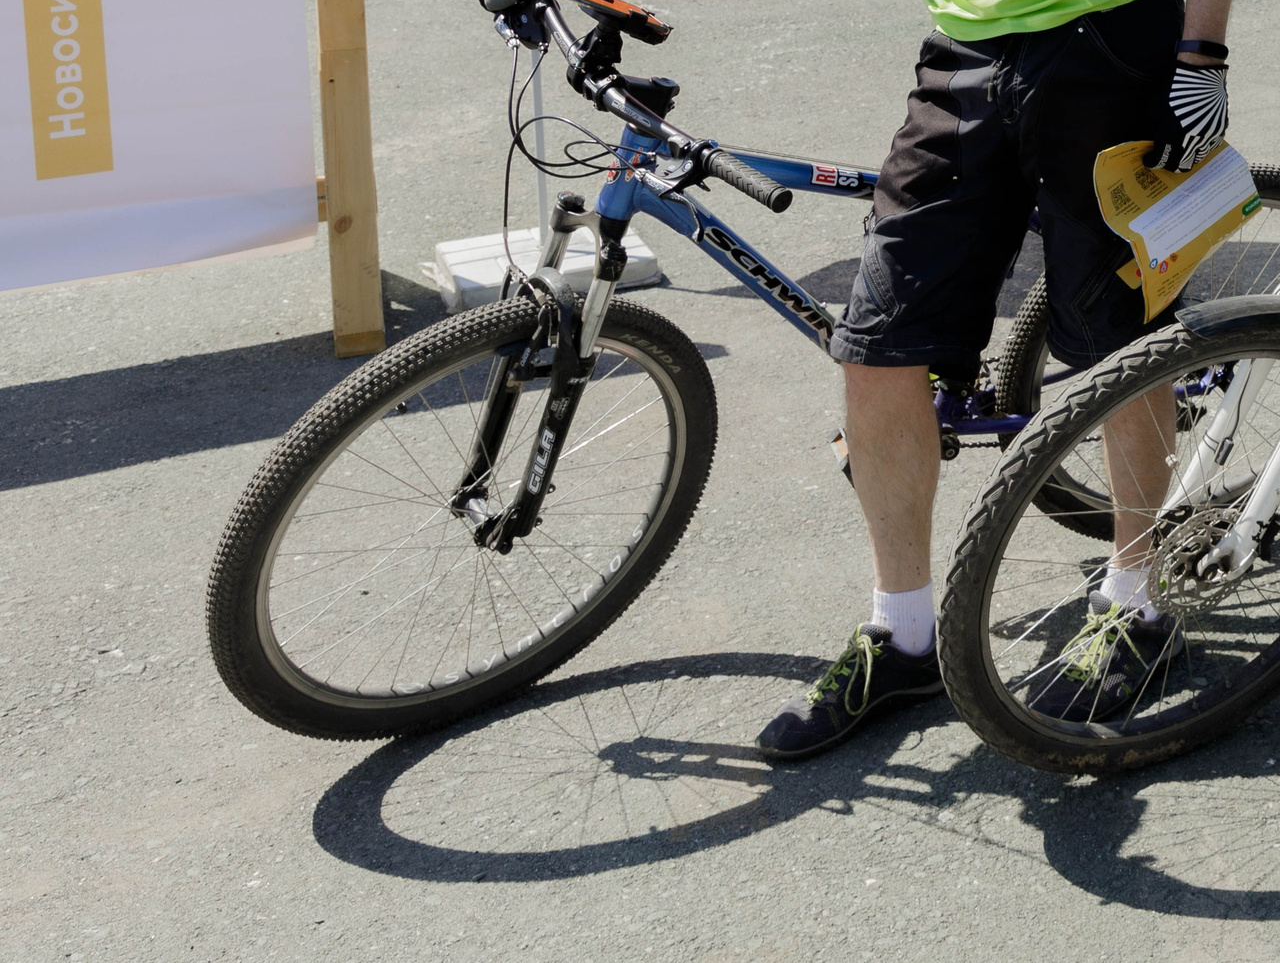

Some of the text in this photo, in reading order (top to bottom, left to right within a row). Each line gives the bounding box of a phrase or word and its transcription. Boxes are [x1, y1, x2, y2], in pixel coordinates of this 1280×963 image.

[703, 226, 834, 341] SCHWIN
[622, 334, 682, 374] KENDA
[527, 426, 556, 495] GILA
